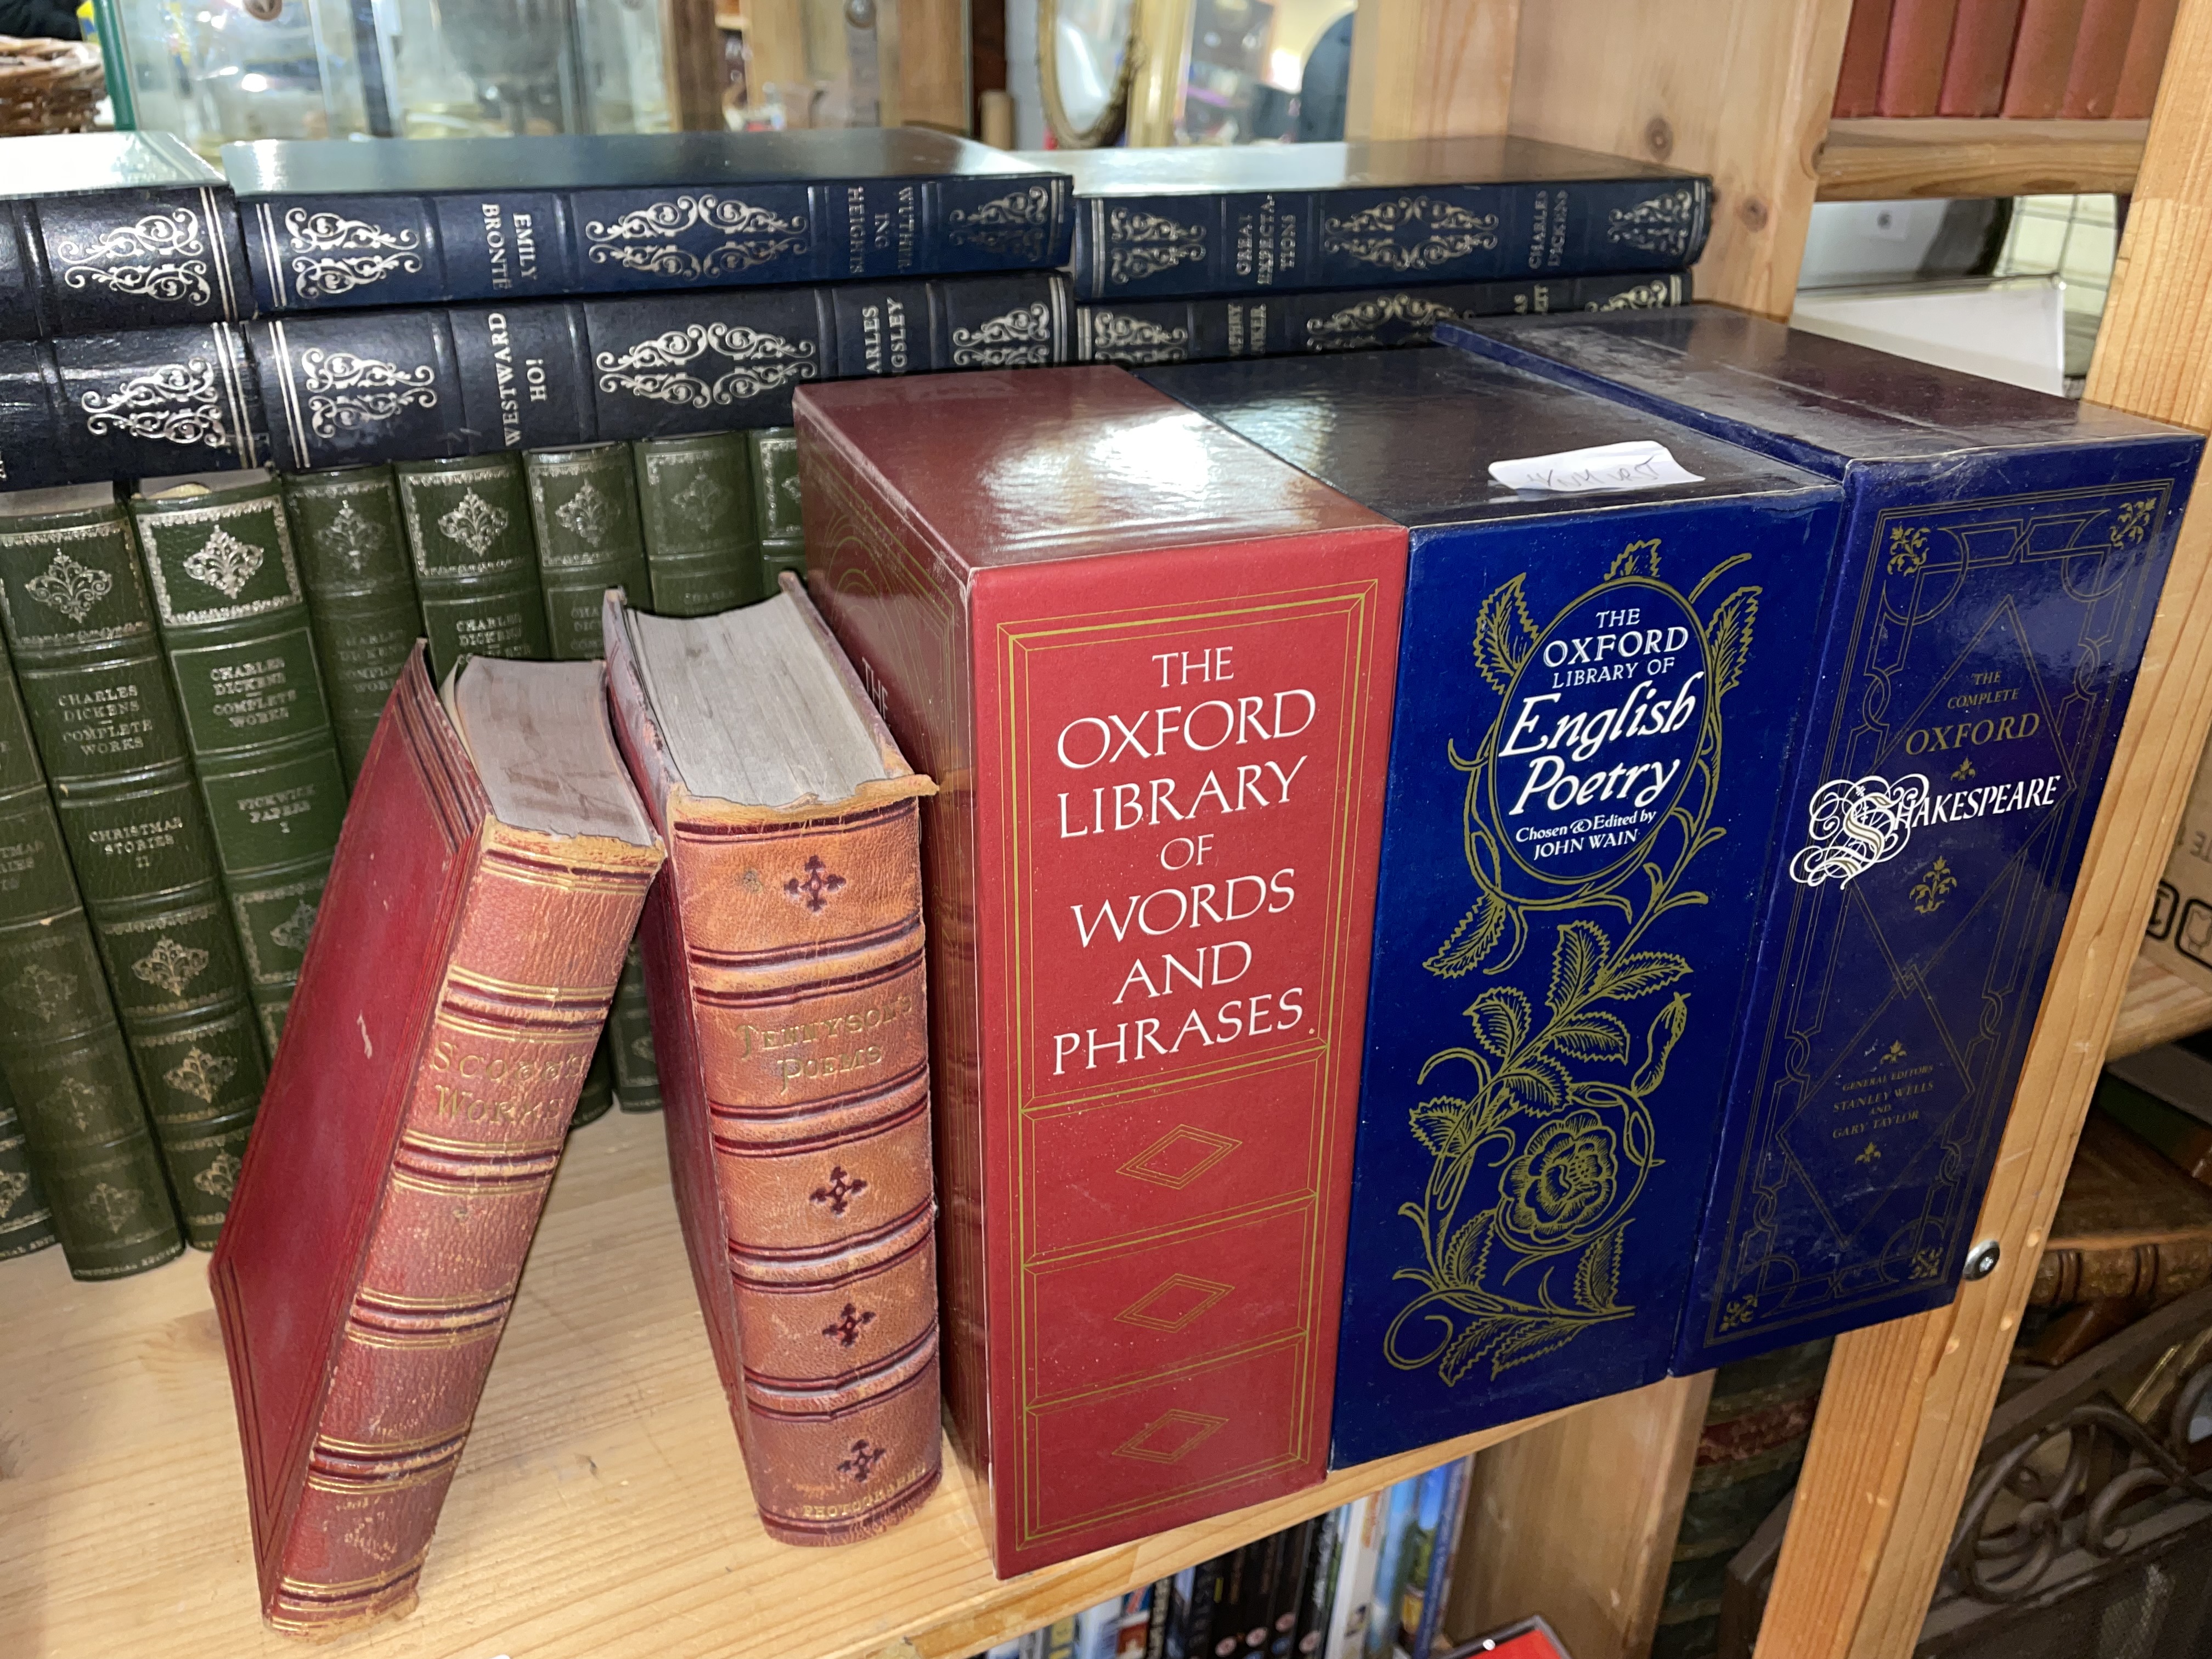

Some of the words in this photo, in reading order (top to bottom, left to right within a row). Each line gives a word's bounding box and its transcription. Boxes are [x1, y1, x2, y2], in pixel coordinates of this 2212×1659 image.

[848, 186, 865, 273] HEIGHTS
[1528, 190, 1548, 269] CHARLES
[513, 213, 537, 280] EMILY
[488, 313, 521, 447] WESTWARD
[526, 359, 548, 402] HO!
[1596, 608, 1640, 628] THE
[1543, 626, 1689, 668] OXFORD
[210, 658, 285, 681] CHARLES
[1152, 646, 1234, 688] THE
[1552, 662, 1638, 689] LIBRARY
[1647, 657, 1675, 675] OF
[1974, 671, 2001, 685] THE
[59, 685, 138, 706] CHARLES
[64, 701, 139, 721] DICKENS
[213, 689, 296, 716] COMPLETE
[1947, 689, 2019, 709] COMPLETE
[63, 719, 153, 742] COMPLETE
[229, 707, 289, 727] WORKS
[1057, 689, 1316, 769] OXFORD
[1498, 671, 1704, 762] English
[80, 737, 144, 755] WORKS
[1905, 713, 2040, 755] OXFORD
[1058, 755, 1308, 838] LIBRARY
[1509, 755, 1680, 815] Poetry
[88, 816, 183, 842] CHRISTMAS
[1516, 825, 1568, 843] Chosen
[1570, 820, 1592, 834] &
[1593, 812, 1637, 830] Edited
[1640, 810, 1657, 824] by
[1790, 773, 2061, 890] SHAKESPEARE
[105, 833, 174, 855] STORIES
[1160, 834, 1214, 870] OF
[1534, 837, 1584, 860] JOHN
[1590, 829, 1638, 849] WAIN
[1071, 868, 1295, 947] WORDS
[1113, 940, 1252, 1004] AND
[777, 1046, 883, 1095] POEMS
[1843, 1075, 1888, 1091] GENERAL
[1833, 1092, 1889, 1113] STANLEY
[1894, 1081, 1934, 1098] WELLS
[1869, 1104, 1892, 1116] AND
[1832, 1123, 1865, 1138] GARY
[1873, 1109, 1919, 1129] TAYLOR
